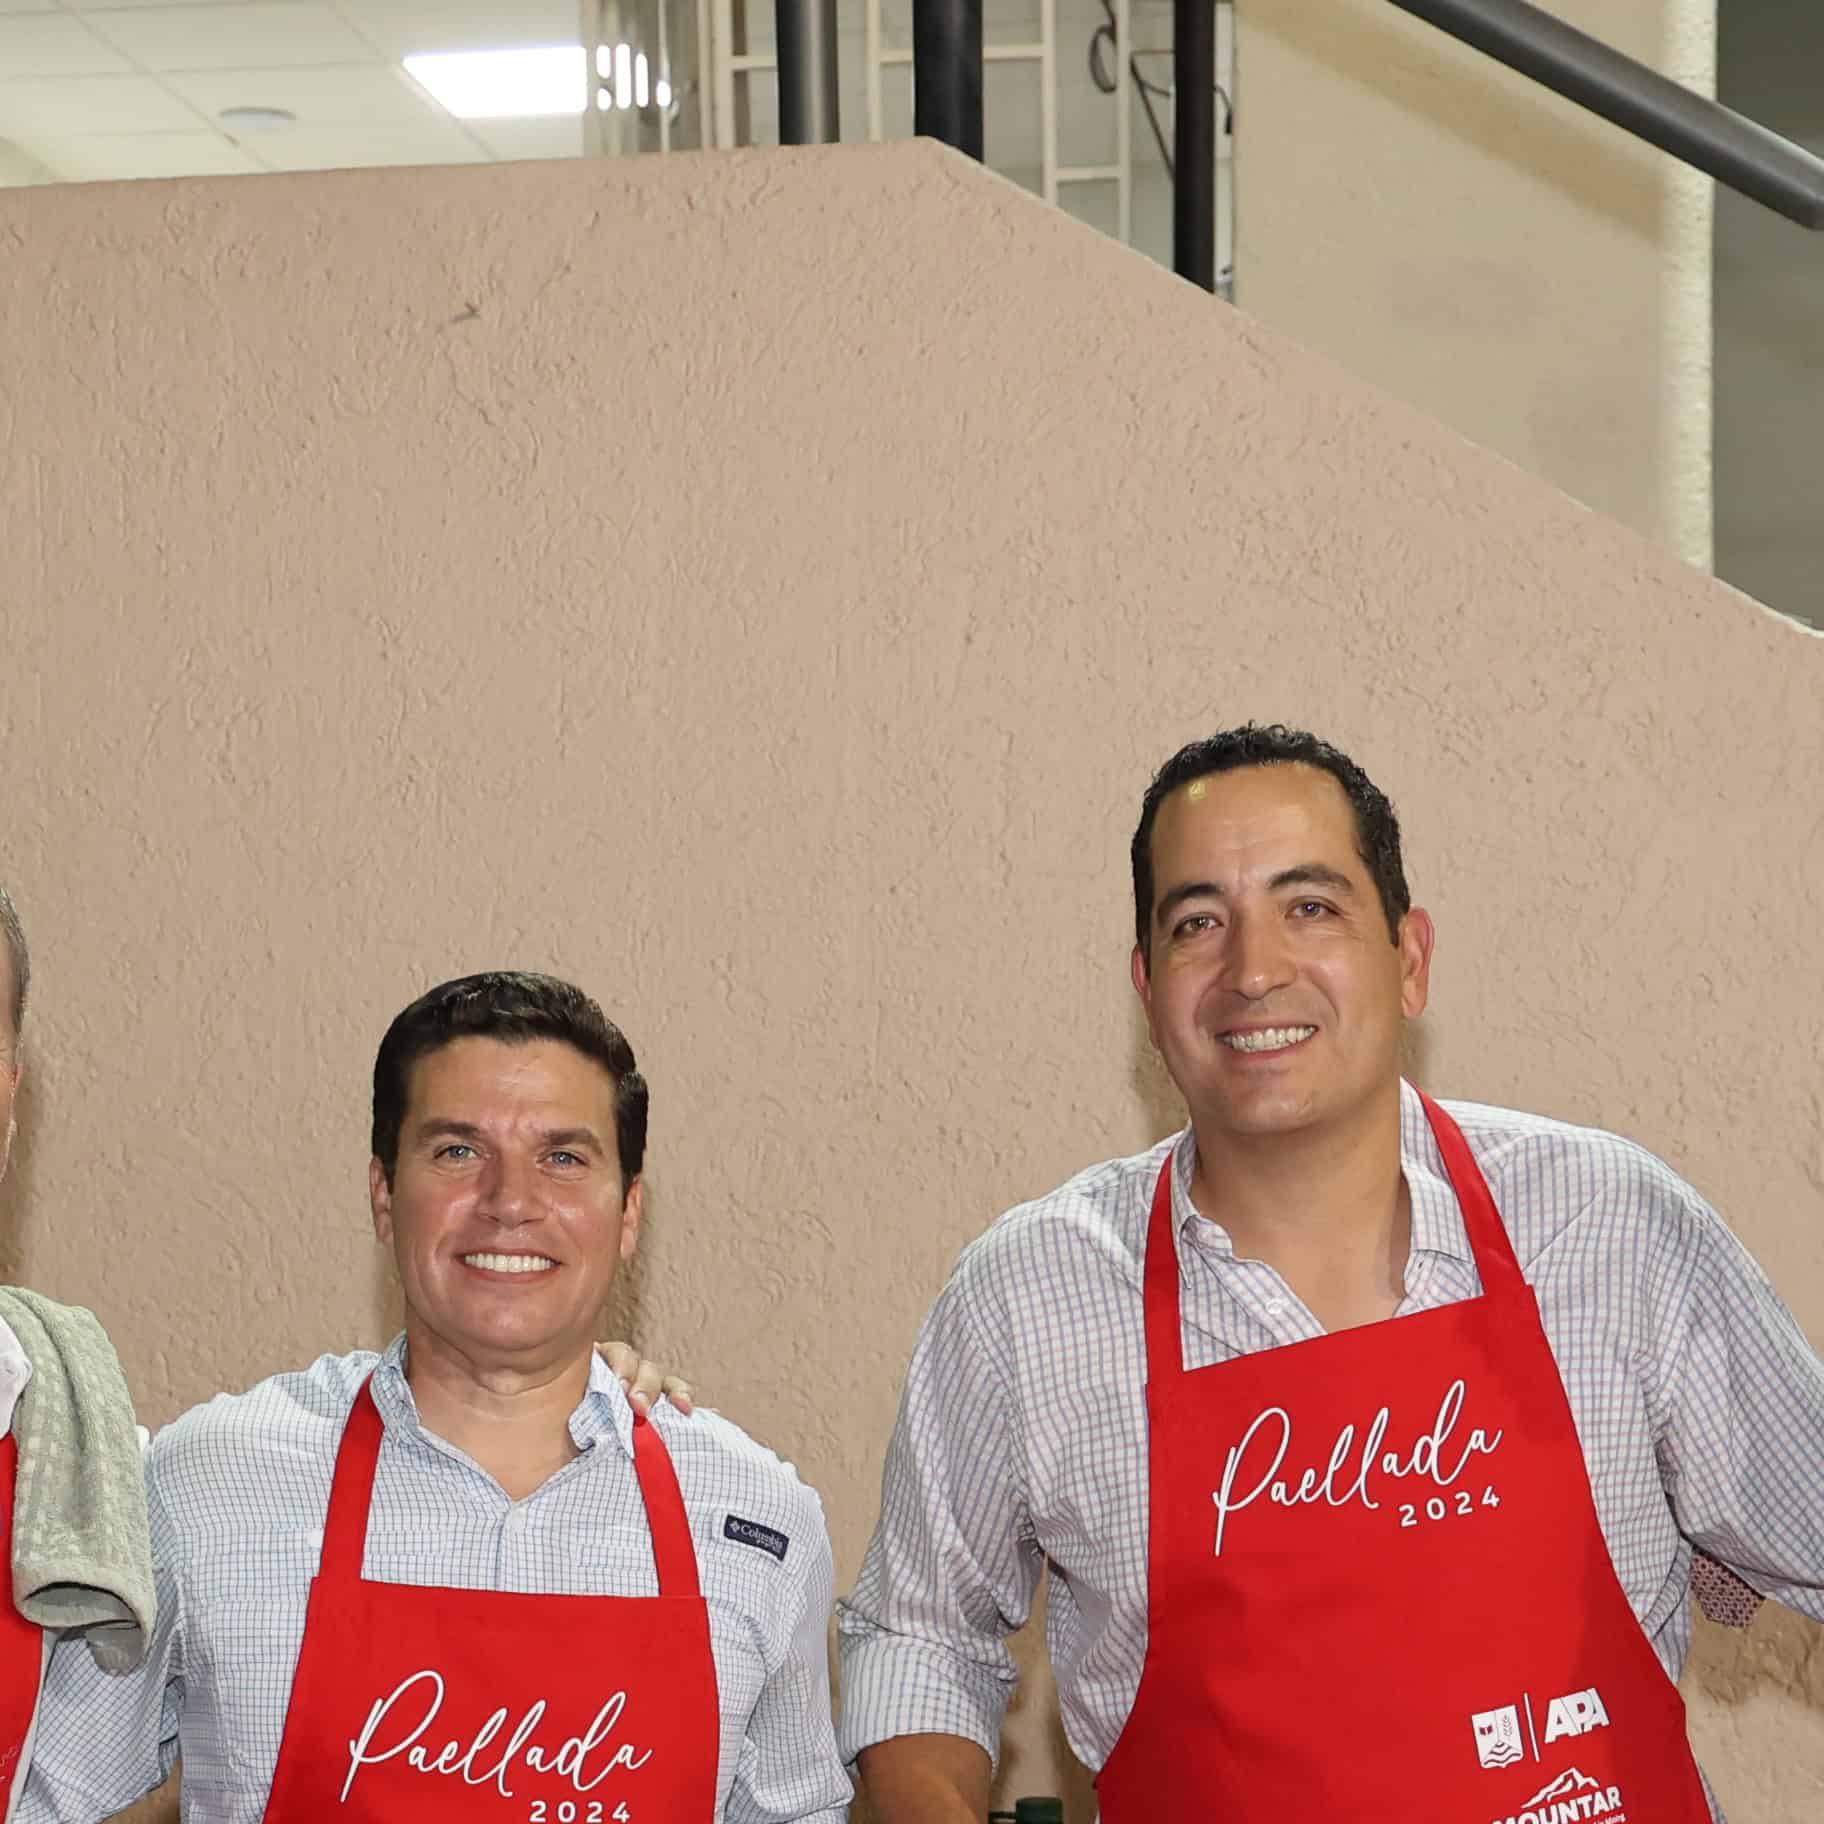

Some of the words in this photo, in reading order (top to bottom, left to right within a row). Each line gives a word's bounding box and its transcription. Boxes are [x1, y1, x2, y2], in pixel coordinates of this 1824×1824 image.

[1213, 1380, 1502, 1556] Paellada
[1399, 1486, 1499, 1526] 2024
[341, 1671, 652, 1802] Paellada
[1545, 1688, 1609, 1743] APA
[530, 1800, 630, 1823] 2024
